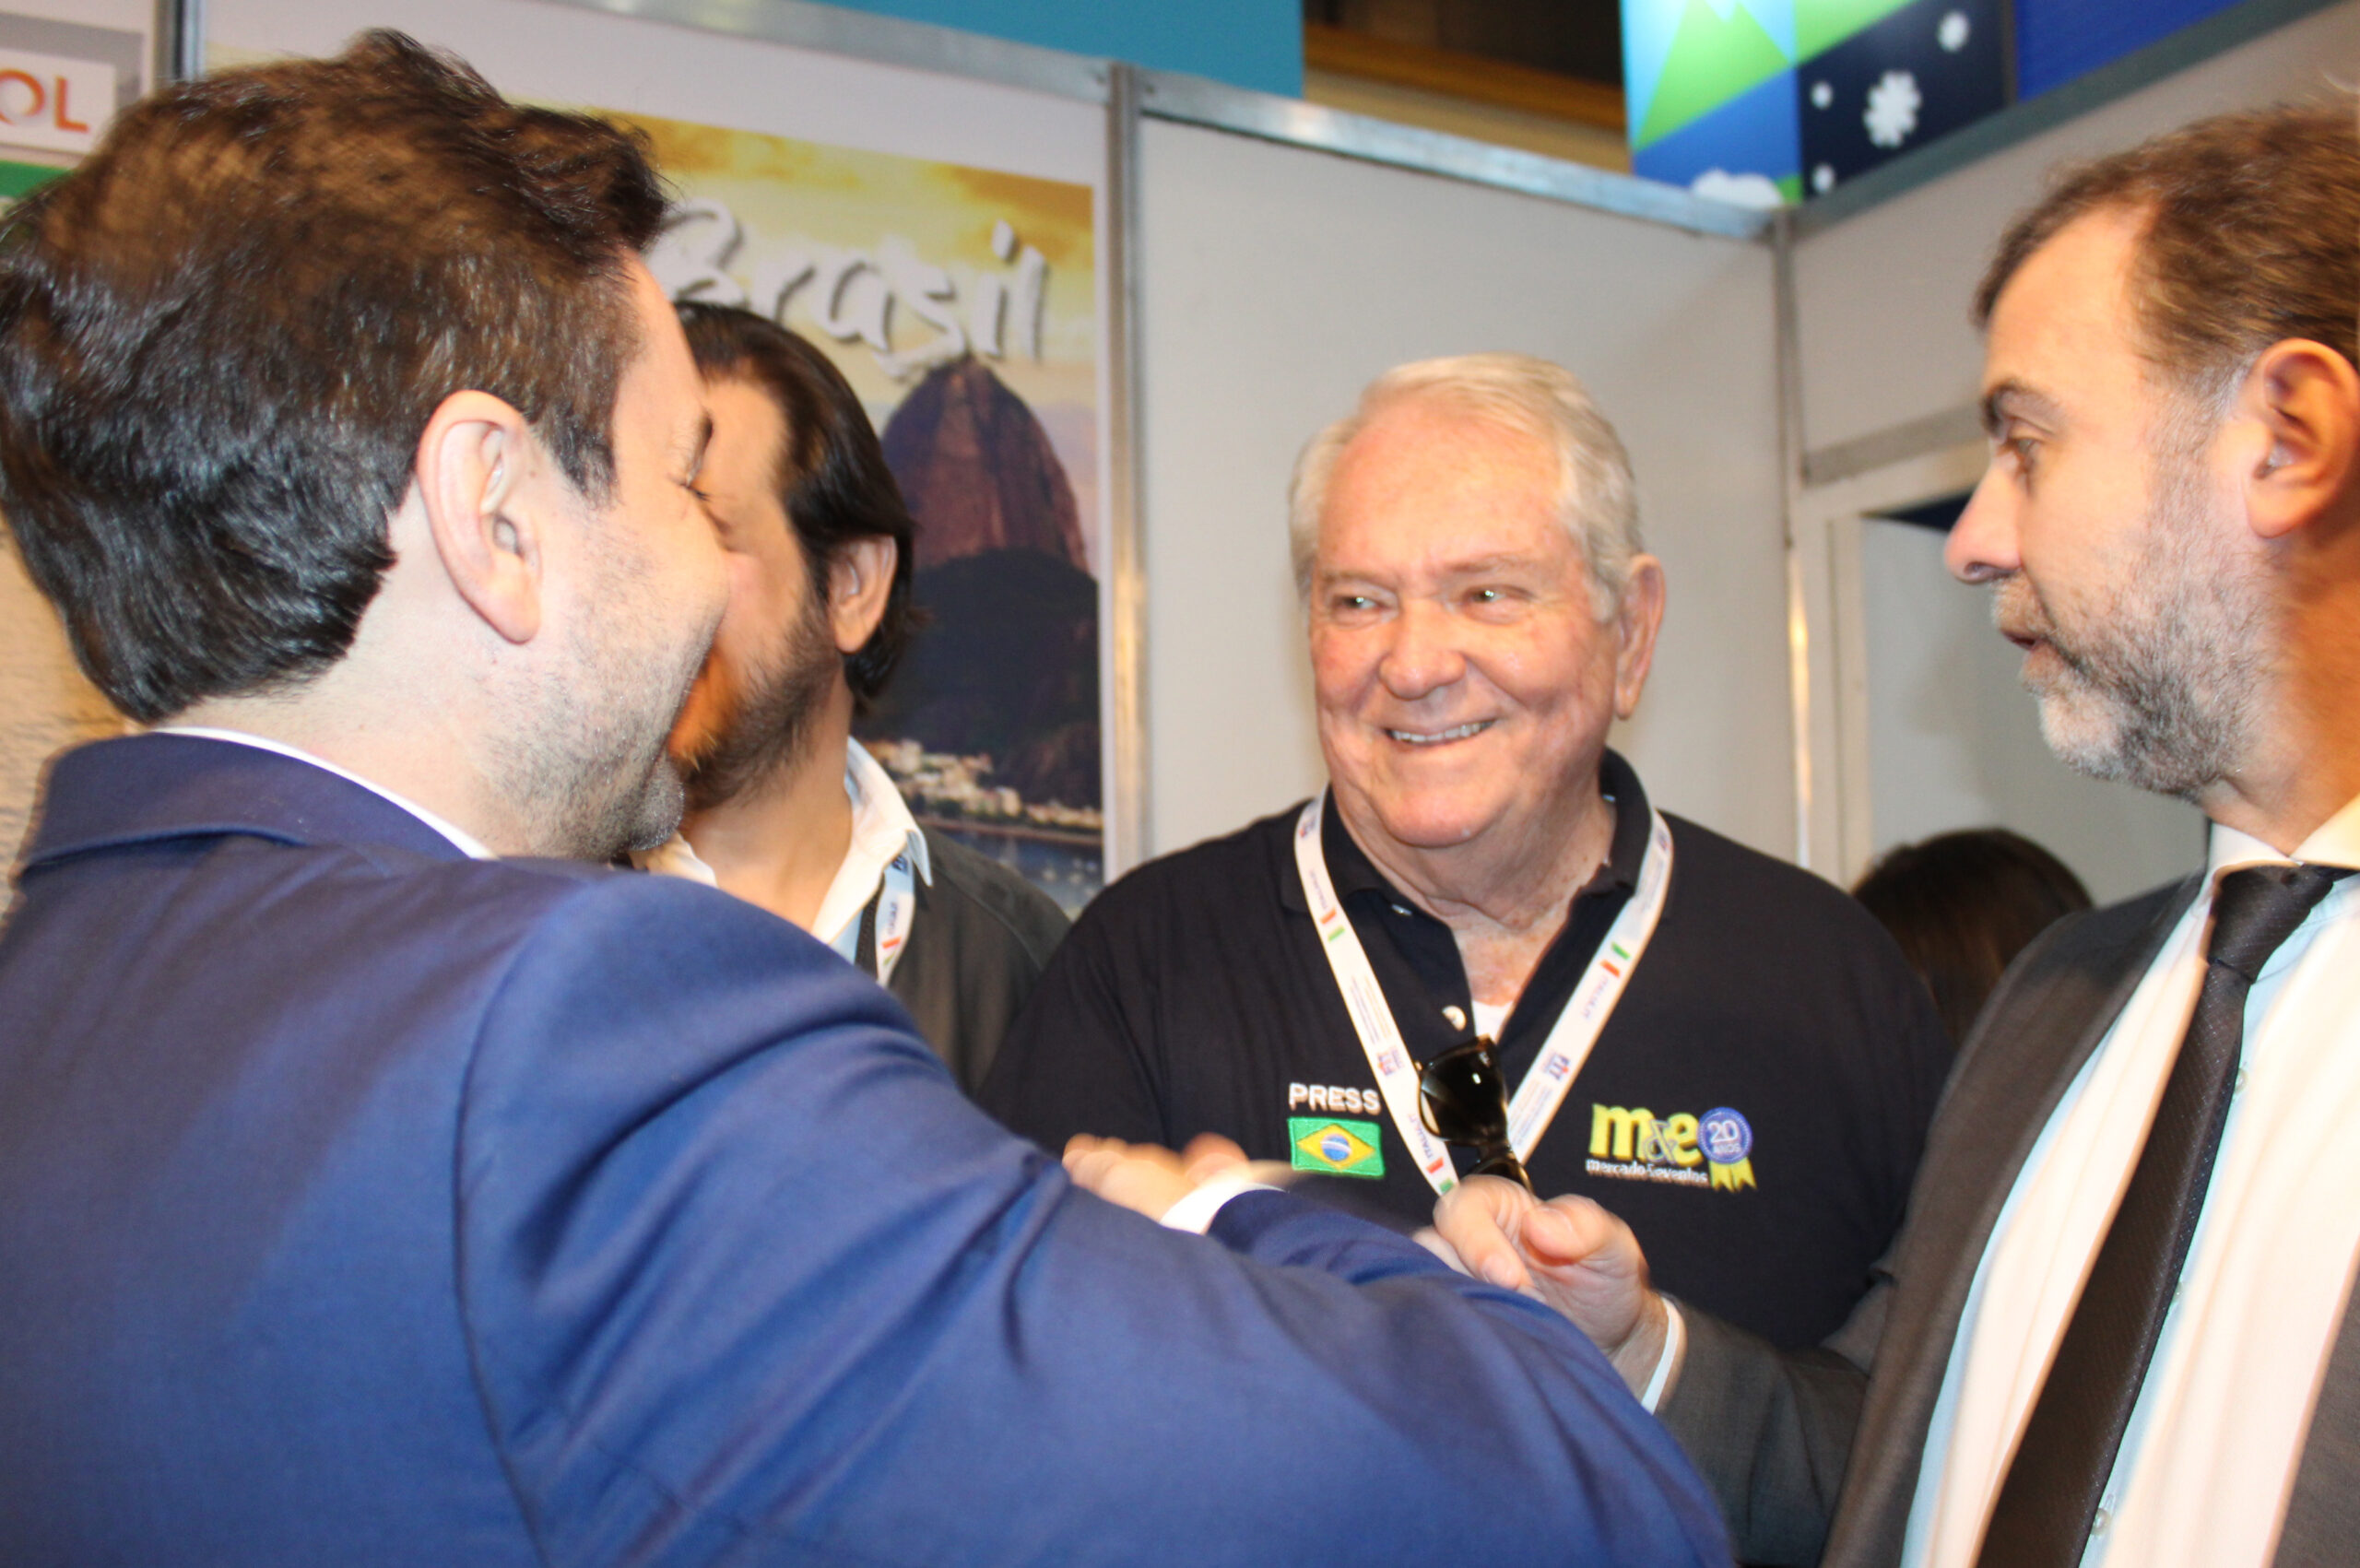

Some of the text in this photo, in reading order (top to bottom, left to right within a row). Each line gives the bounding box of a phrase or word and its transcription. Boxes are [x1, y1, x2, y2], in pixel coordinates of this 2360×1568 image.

[644, 197, 1047, 380] Brasil
[1289, 1082, 1381, 1115] PRESS
[1707, 1119, 1739, 1143] 20
